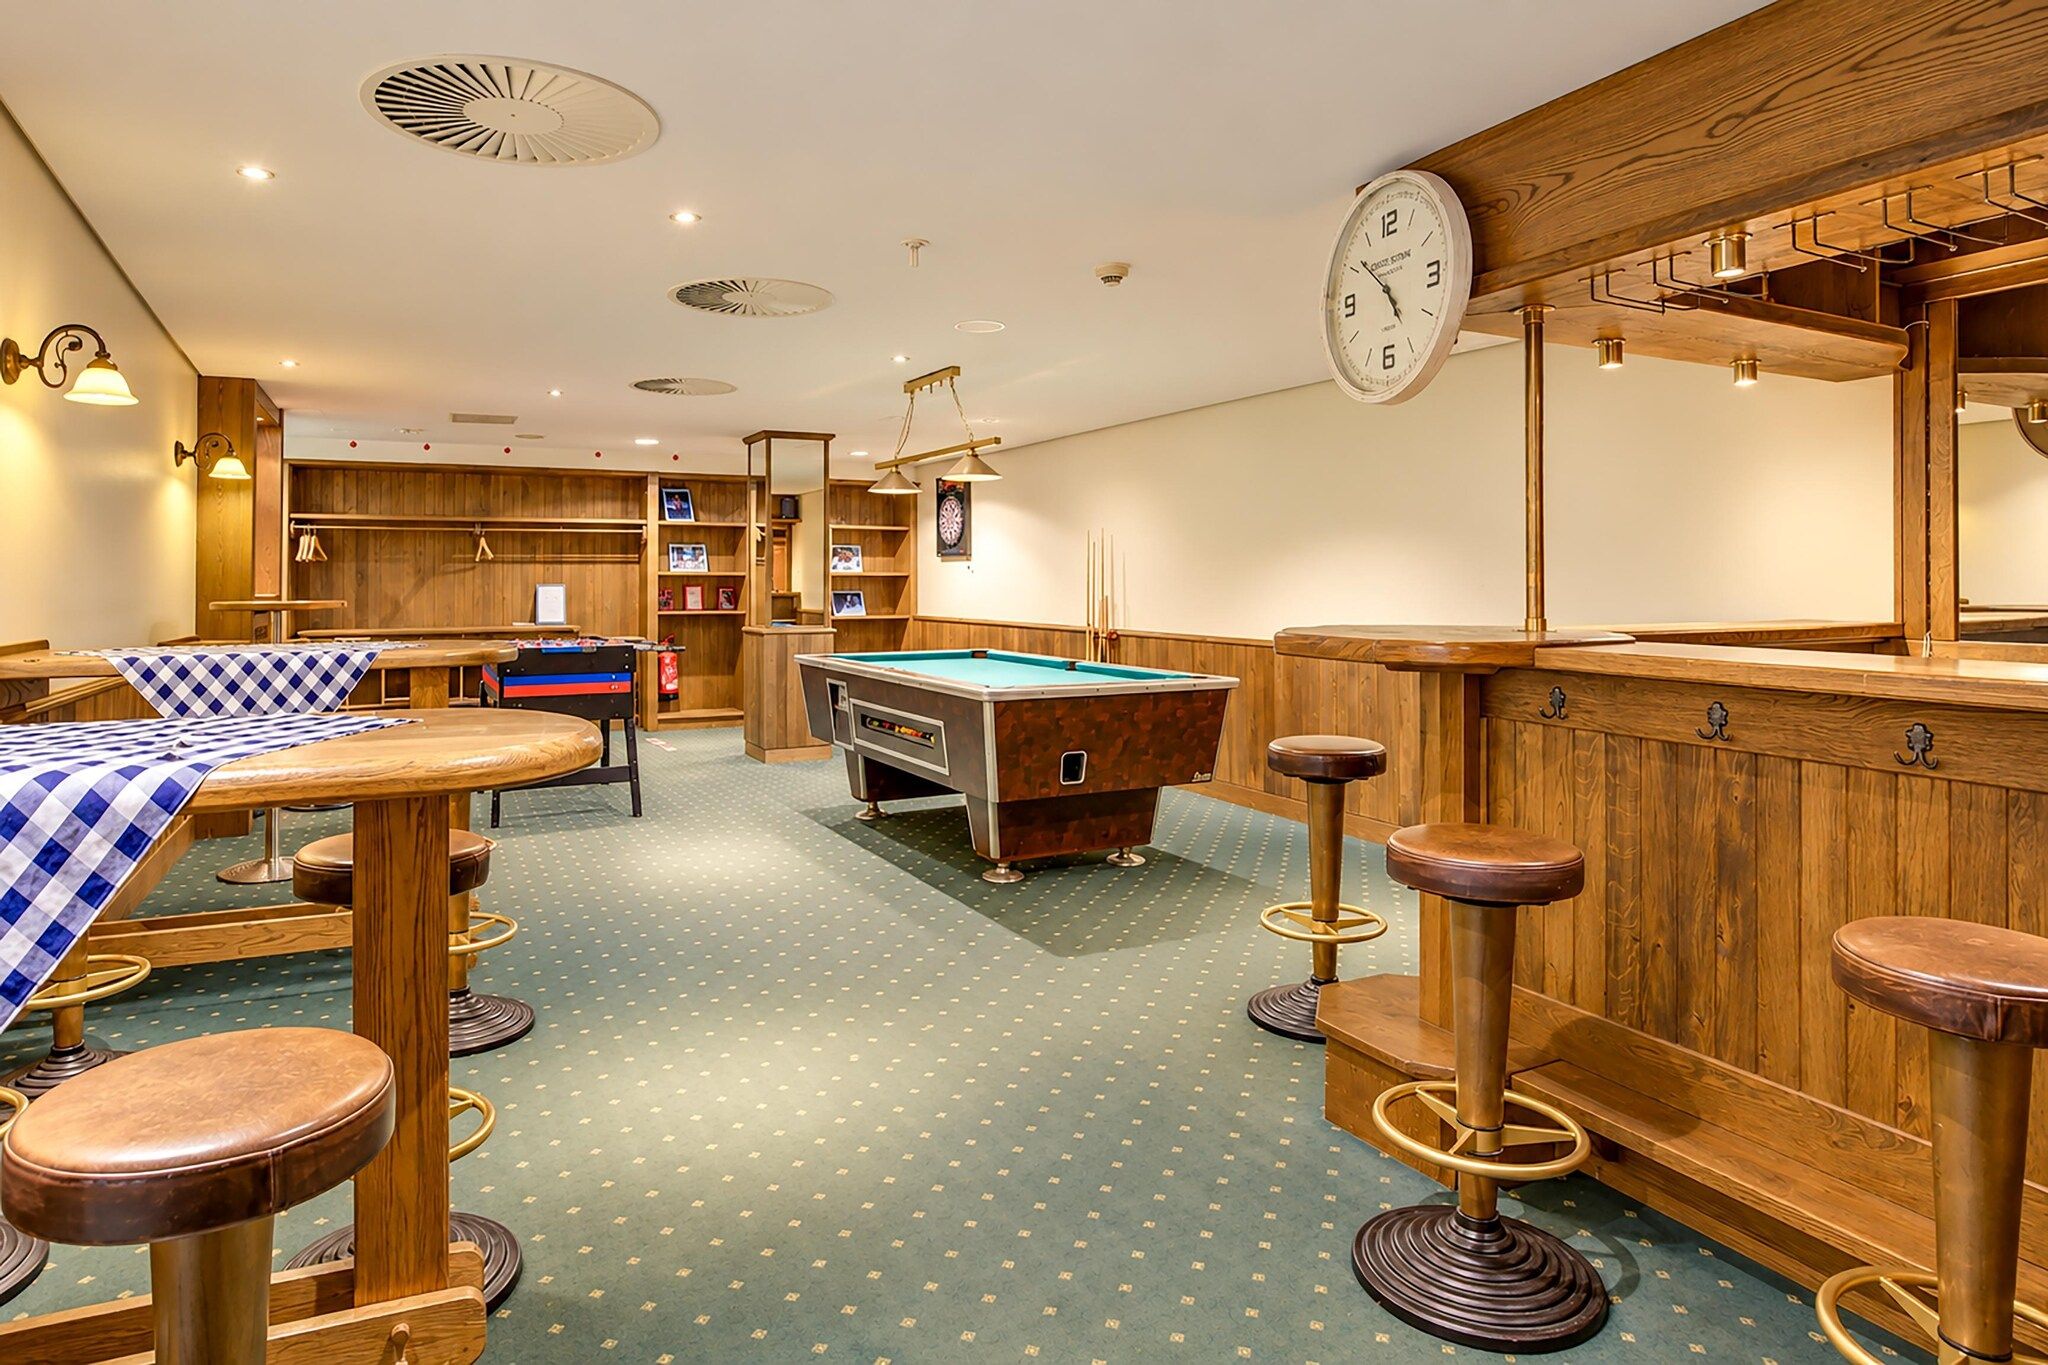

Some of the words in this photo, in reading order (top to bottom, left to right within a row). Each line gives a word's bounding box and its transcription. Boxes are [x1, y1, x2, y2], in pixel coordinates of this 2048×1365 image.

[1381, 208, 1398, 239] 12
[1426, 260, 1441, 289] 3
[1344, 293, 1356, 318] 9
[1382, 343, 1396, 370] 6
